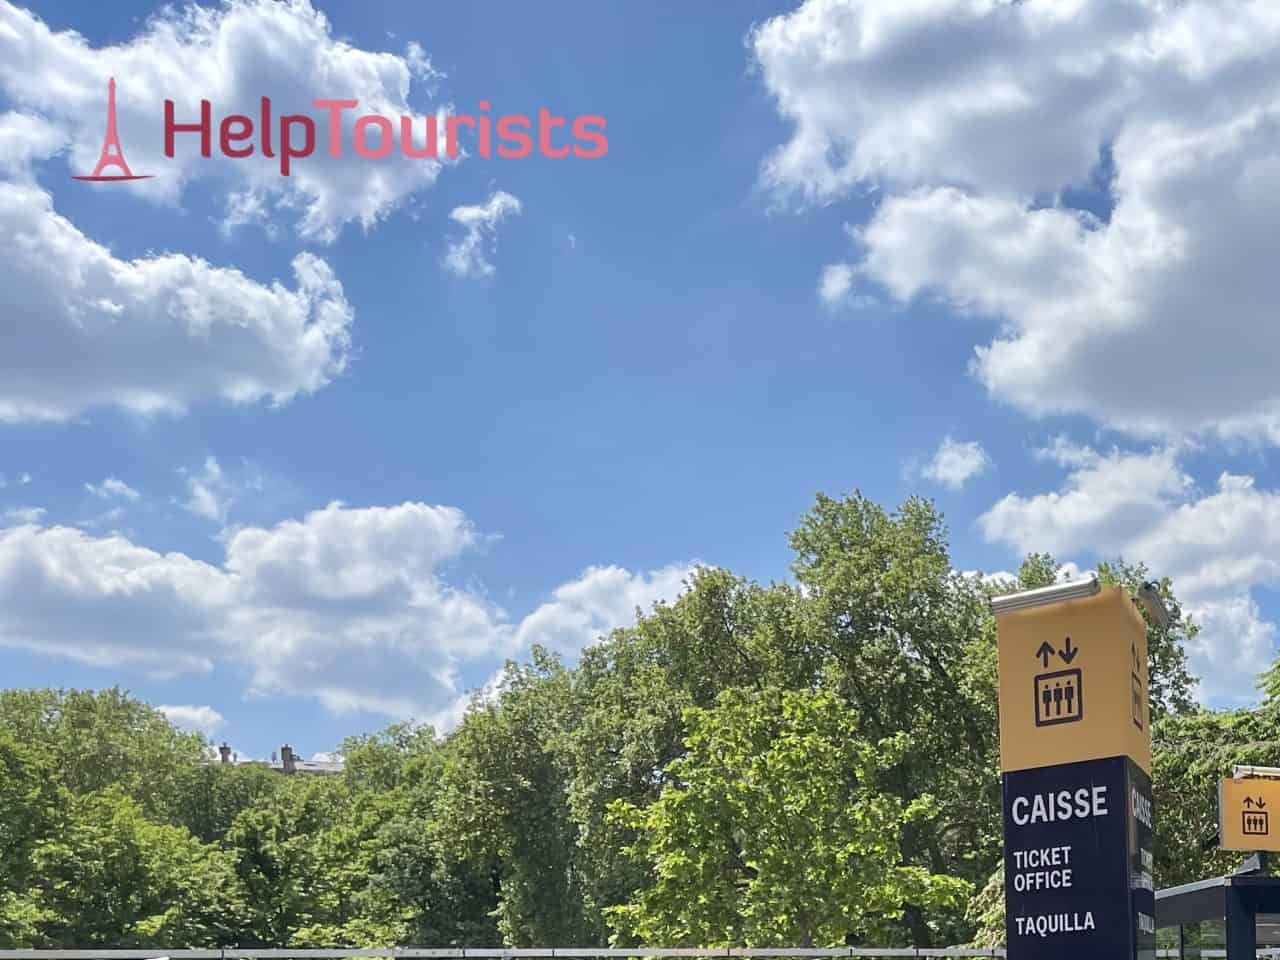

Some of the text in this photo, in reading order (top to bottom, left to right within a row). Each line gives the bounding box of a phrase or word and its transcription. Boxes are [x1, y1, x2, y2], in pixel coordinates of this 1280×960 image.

[1012, 786, 1108, 826] CAISSE
[1013, 846, 1072, 869] TICKET
[1014, 869, 1072, 892] OFFICE
[1015, 911, 1095, 937] TAQUILLA
